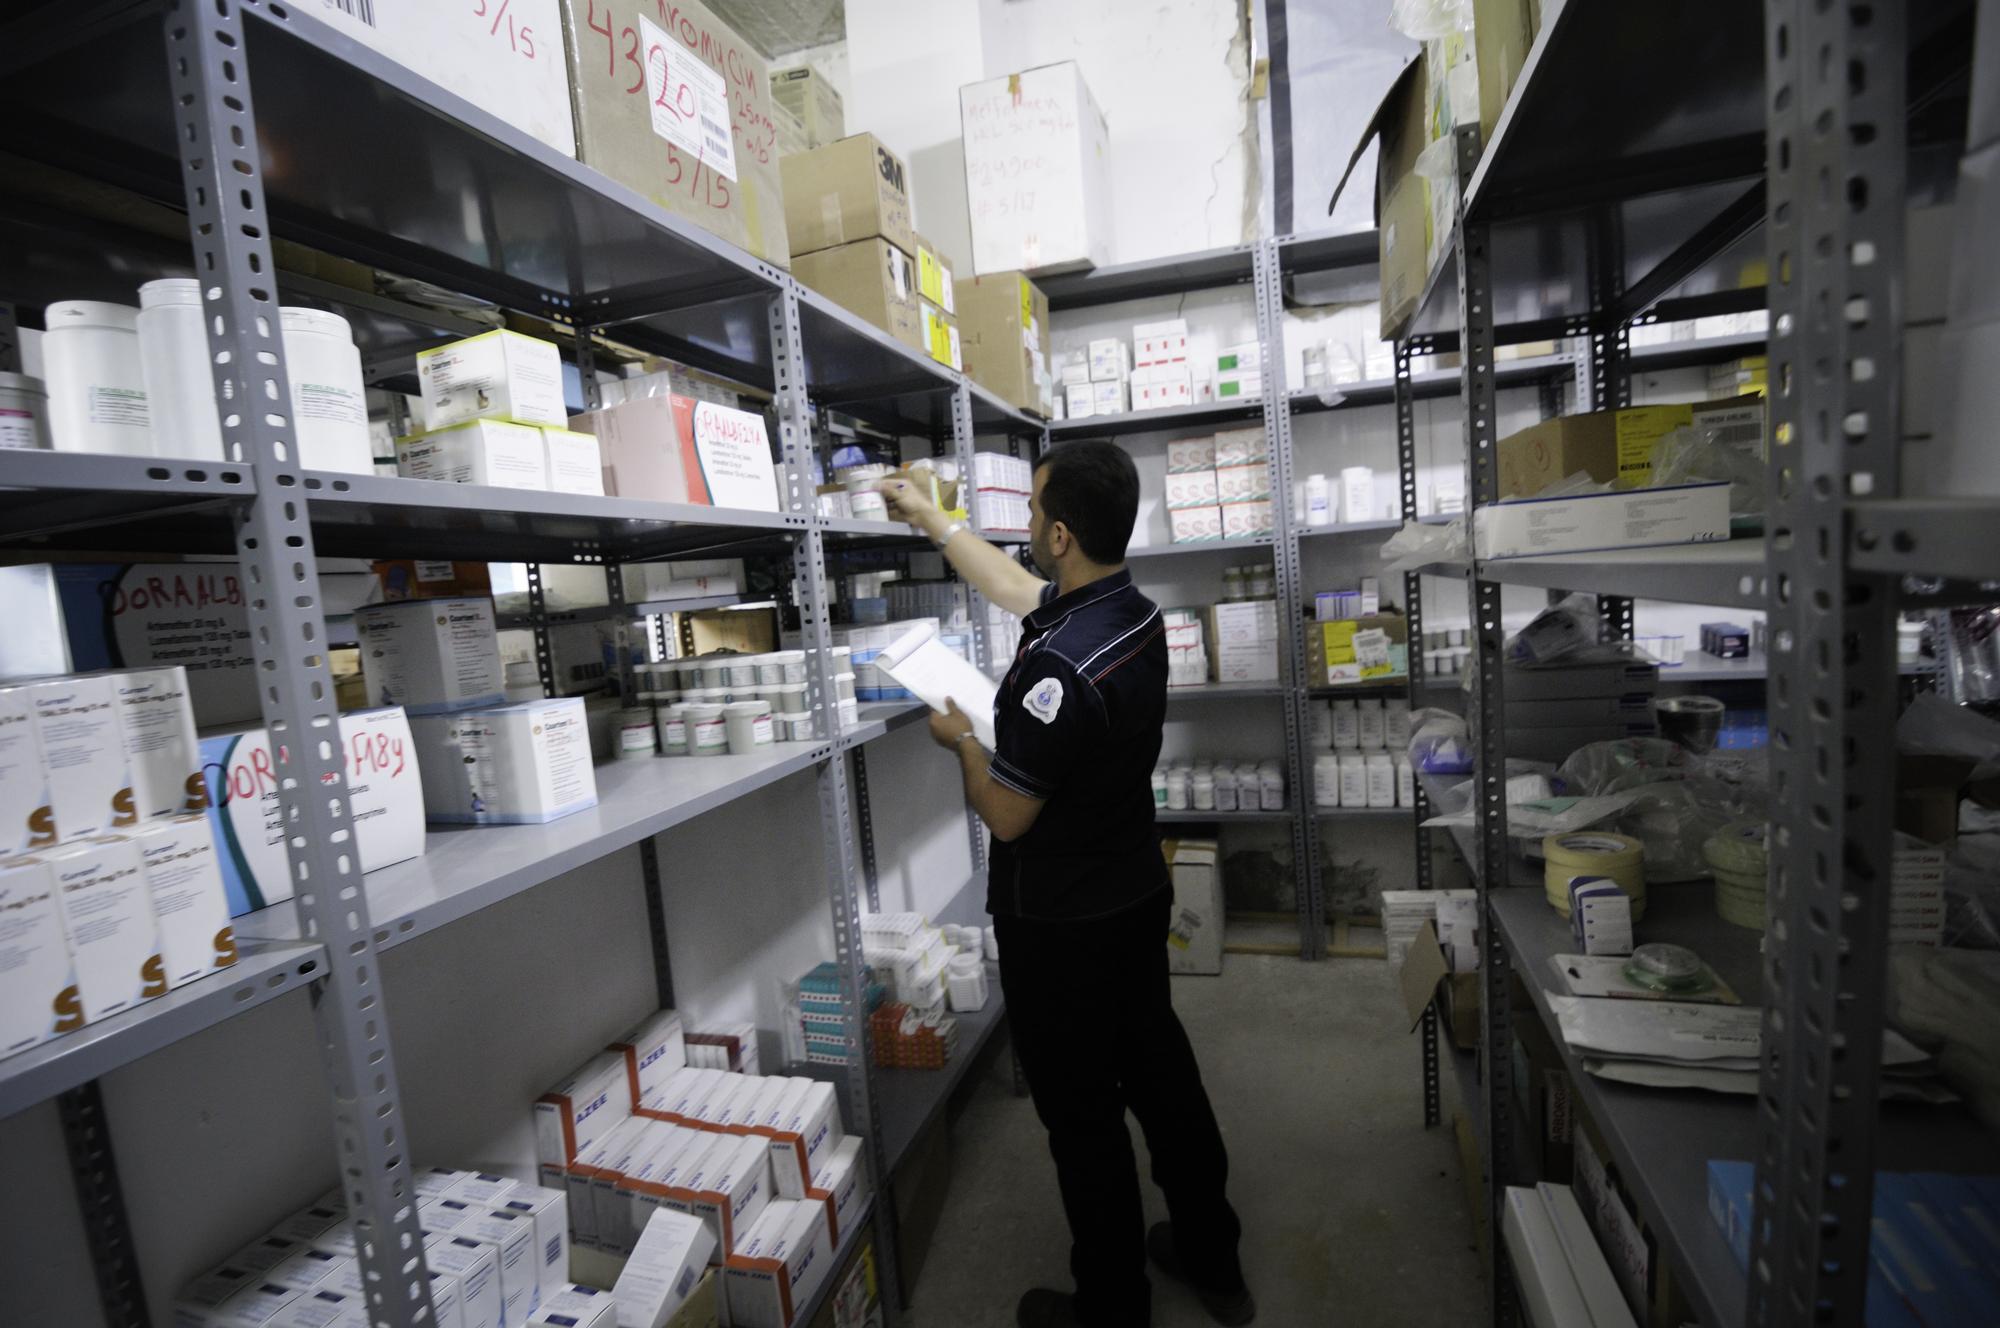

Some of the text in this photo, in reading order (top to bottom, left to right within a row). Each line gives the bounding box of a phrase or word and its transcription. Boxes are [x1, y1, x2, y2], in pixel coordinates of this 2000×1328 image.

[588, 0, 644, 94] 43
[649, 44, 696, 122] 20
[667, 142, 730, 209] 5/15
[878, 147, 905, 195] 3M
[639, 1044, 667, 1071] AZEE
[576, 1093, 608, 1125] AZEE
[808, 1124, 829, 1158] AZEE
[733, 1181, 759, 1219] AZEE
[791, 1247, 815, 1288] AZEE
